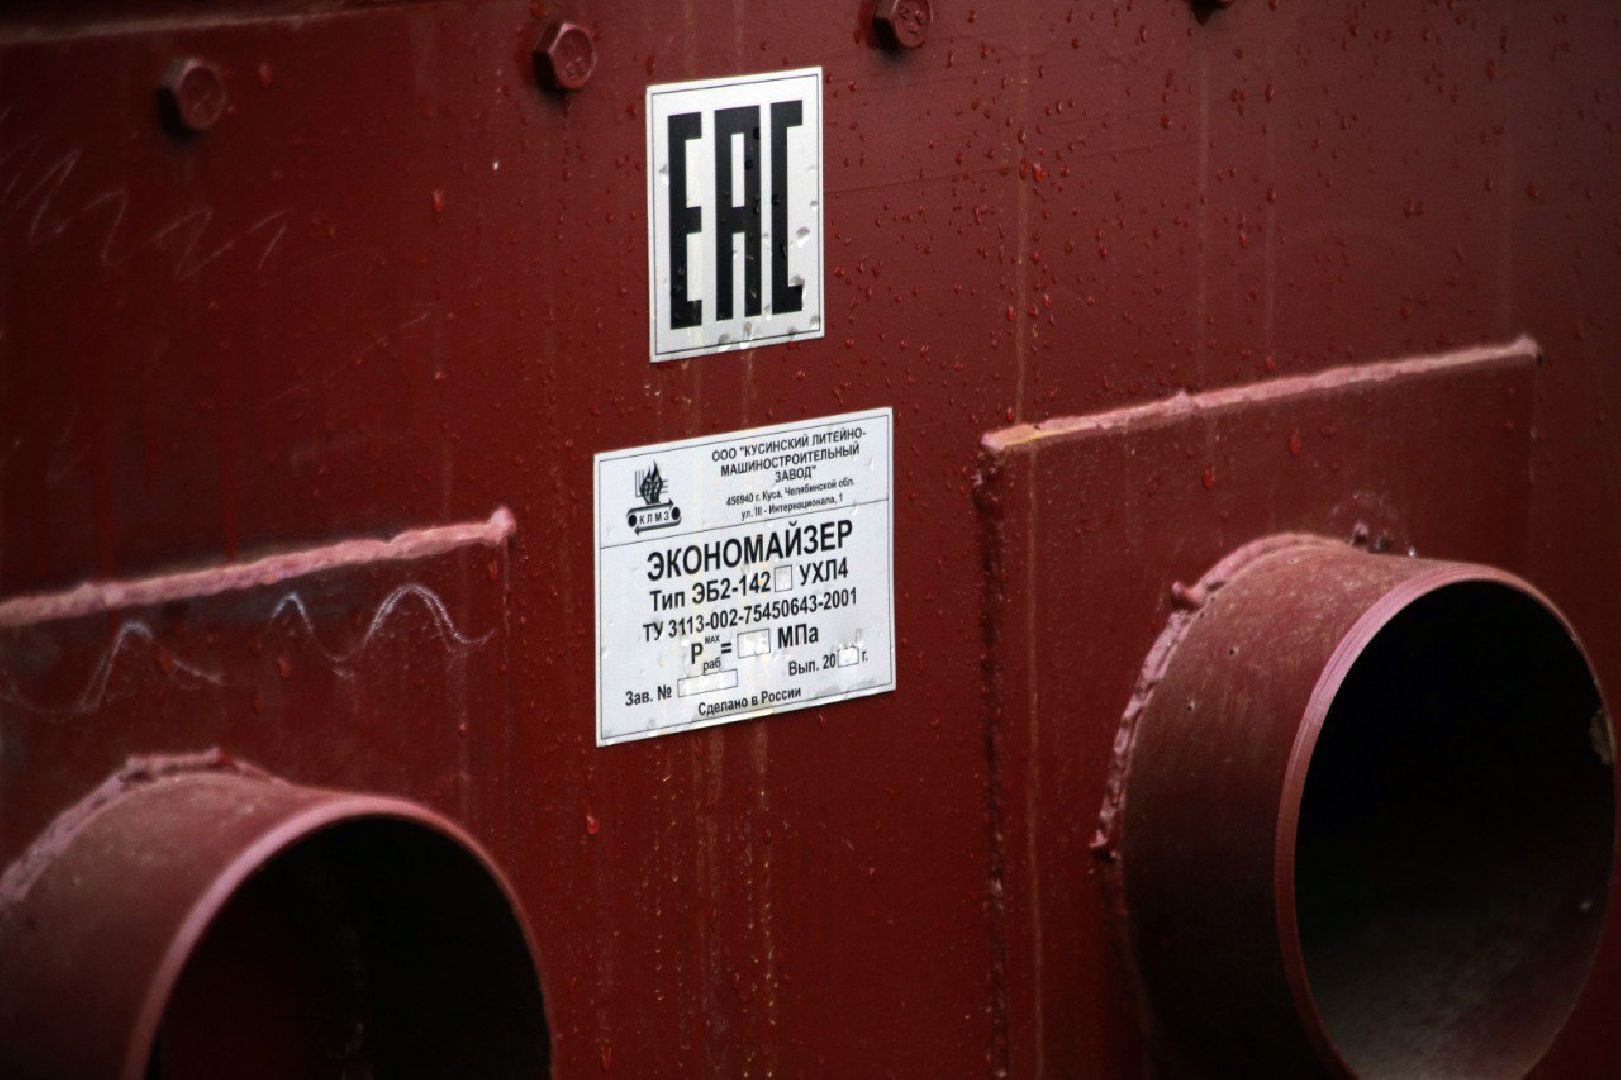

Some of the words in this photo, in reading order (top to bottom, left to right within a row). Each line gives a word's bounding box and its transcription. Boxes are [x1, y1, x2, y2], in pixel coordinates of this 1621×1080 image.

[712, 448, 737, 462] ООО
[740, 434, 809, 458] "КУСИНСКИЙ
[812, 426, 866, 445] ЛИТЕЙНО-
[720, 441, 860, 477] МАШИНОСТРОИТЕЛЬНЫЙ
[775, 465, 816, 483] ЗАВОД"
[785, 479, 836, 497] Челябинской
[647, 519, 853, 582] ЭКОНОМАЙЗЕР
[650, 589, 686, 612] Тип
[691, 570, 772, 605] ЭБ2-142
[799, 557, 849, 587] УХЛ4
[643, 622, 664, 643] ТУ
[668, 586, 858, 639] 3113-002-75450643-2001
[777, 623, 819, 650] МПа
[788, 660, 820, 677] Вып.
[822, 653, 836, 670] 20
[624, 691, 653, 707] Зав.
[657, 685, 672, 700] №
[698, 697, 748, 717] Сделано
[751, 696, 758, 706] в
[761, 686, 802, 705] России
